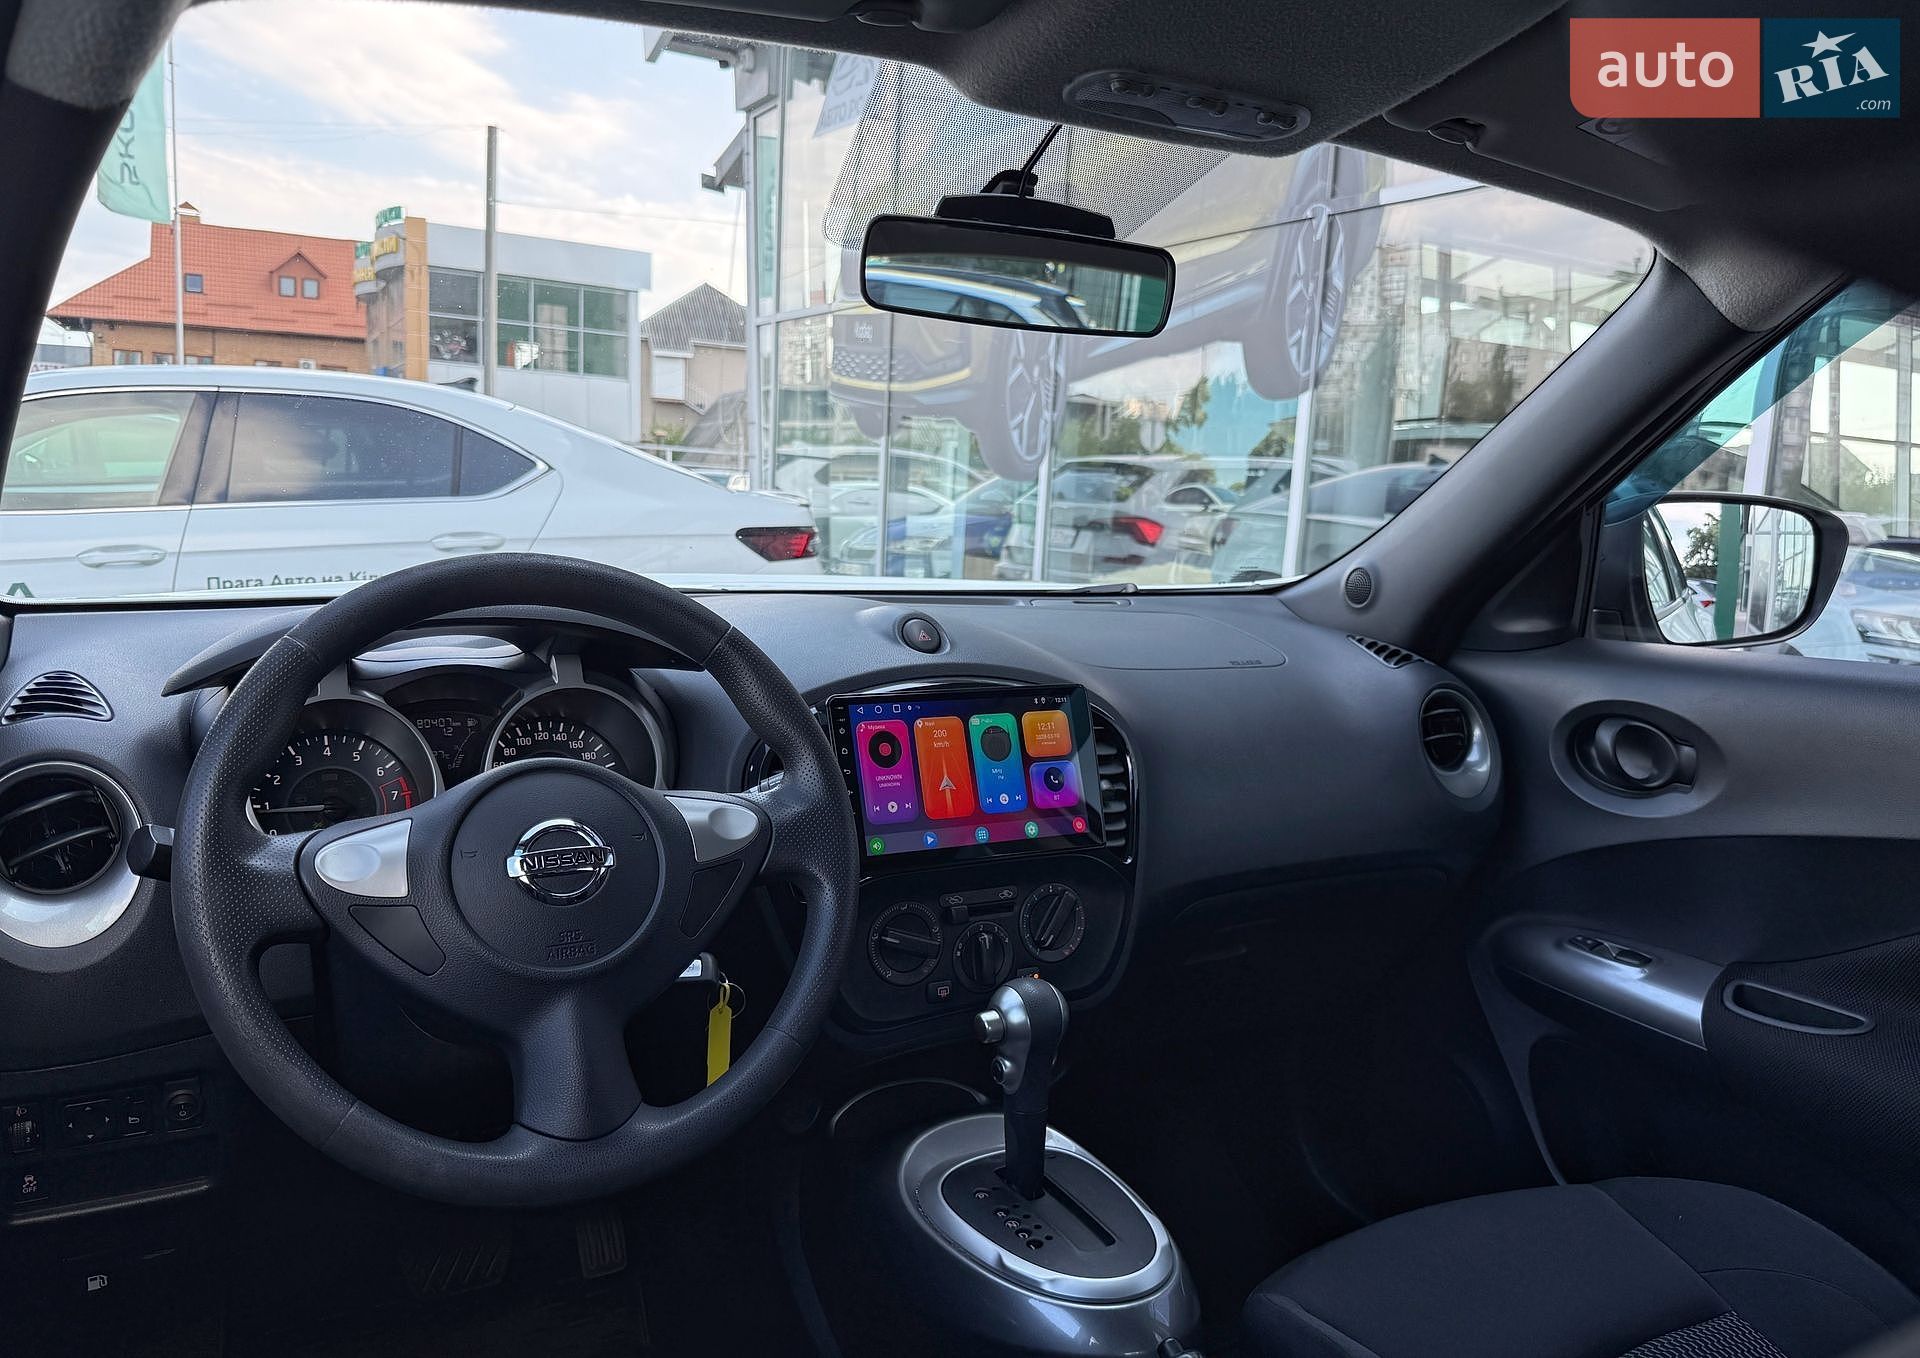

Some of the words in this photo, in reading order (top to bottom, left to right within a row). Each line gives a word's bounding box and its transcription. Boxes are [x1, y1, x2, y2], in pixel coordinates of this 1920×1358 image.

[207, 576, 264, 590] Прага
[270, 574, 317, 586] Авто
[533, 732, 549, 740] 120
[552, 733, 568, 741] 140
[933, 729, 948, 738] 200
[516, 737, 532, 746] 100
[568, 740, 584, 749] 160
[933, 740, 950, 748] km/h
[323, 746, 331, 757] 4
[503, 747, 517, 756] 80
[581, 751, 597, 760] 180
[295, 755, 303, 766] 3
[352, 751, 361, 762] 5
[376, 766, 385, 777] 6
[273, 774, 281, 785] 2
[391, 790, 399, 800] 7
[264, 801, 271, 810] 1
[523, 849, 605, 872] NISSAN
[22, 1186, 38, 1194] OFF
